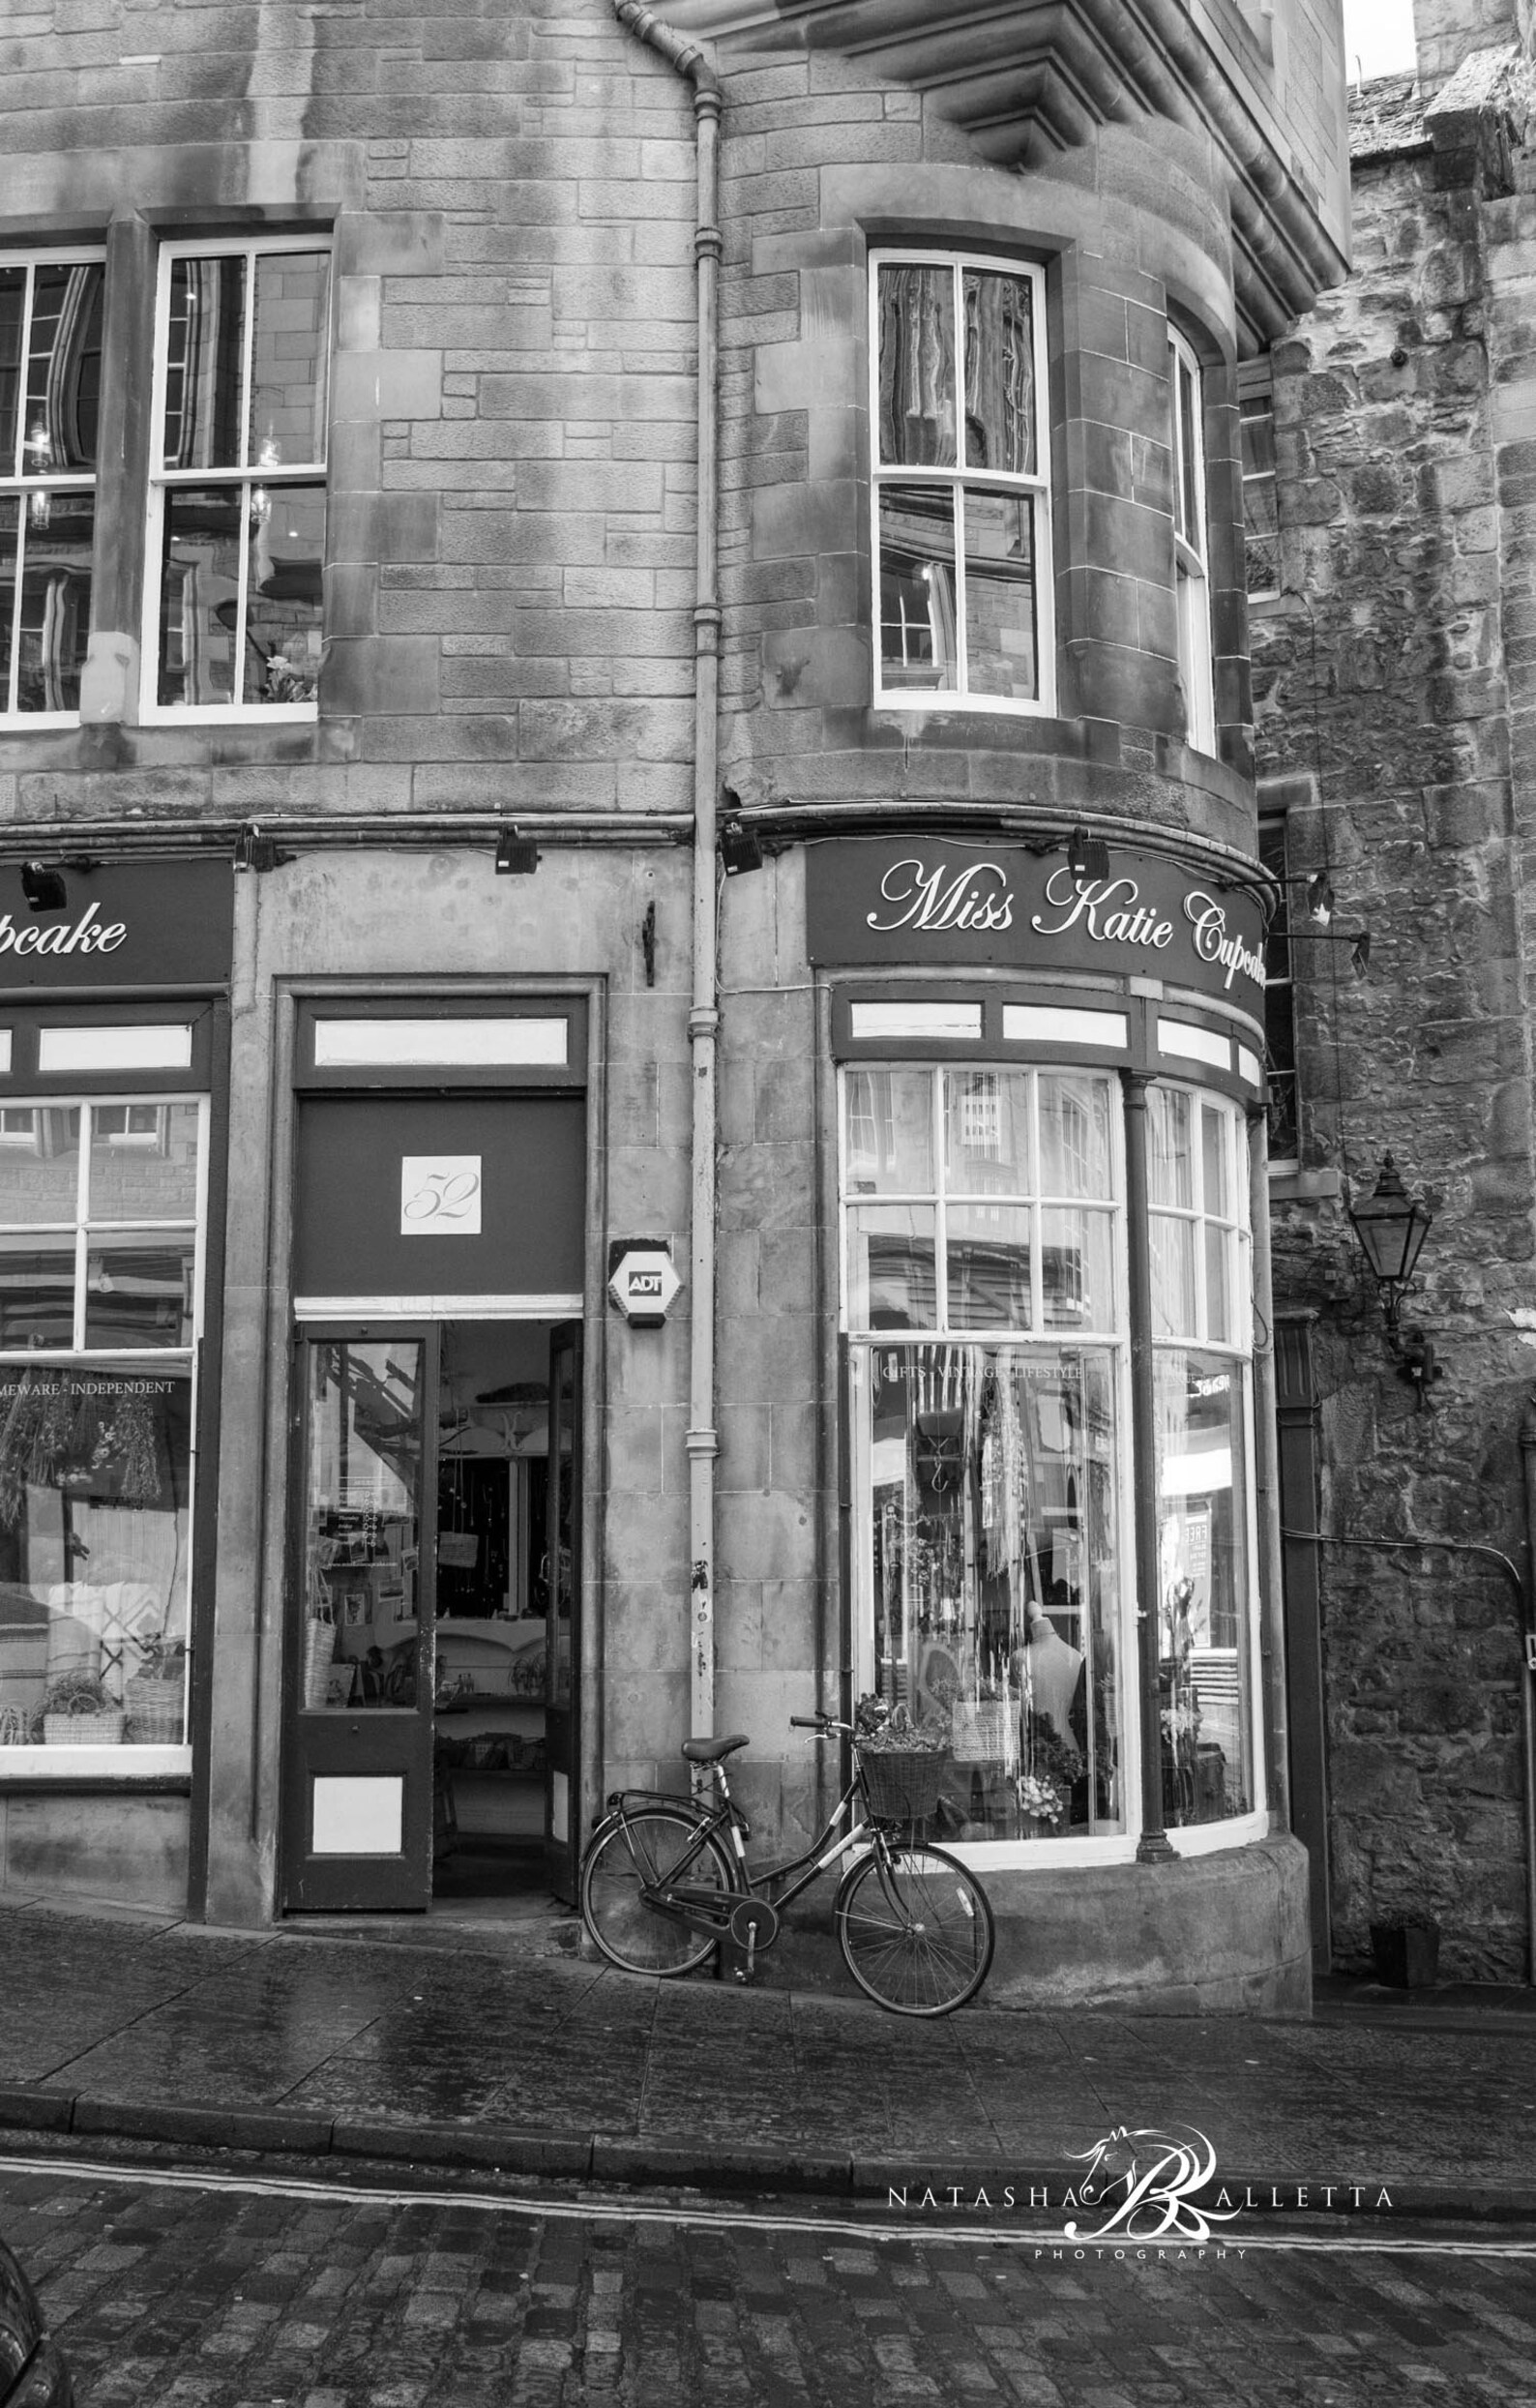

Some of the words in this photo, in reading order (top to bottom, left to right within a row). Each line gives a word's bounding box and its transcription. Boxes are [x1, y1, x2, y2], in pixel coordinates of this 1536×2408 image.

[867, 860, 1015, 932] Miss
[1032, 865, 1173, 948] Katie
[403, 1172, 480, 1220] 52
[629, 1275, 663, 1292] ADT
[882, 1365, 927, 1379] GIFTS
[937, 1365, 1004, 1379] VINTAGE
[1016, 1366, 1082, 1380] LIFESTYLE
[71, 1381, 176, 1395] INDEPENDENT
